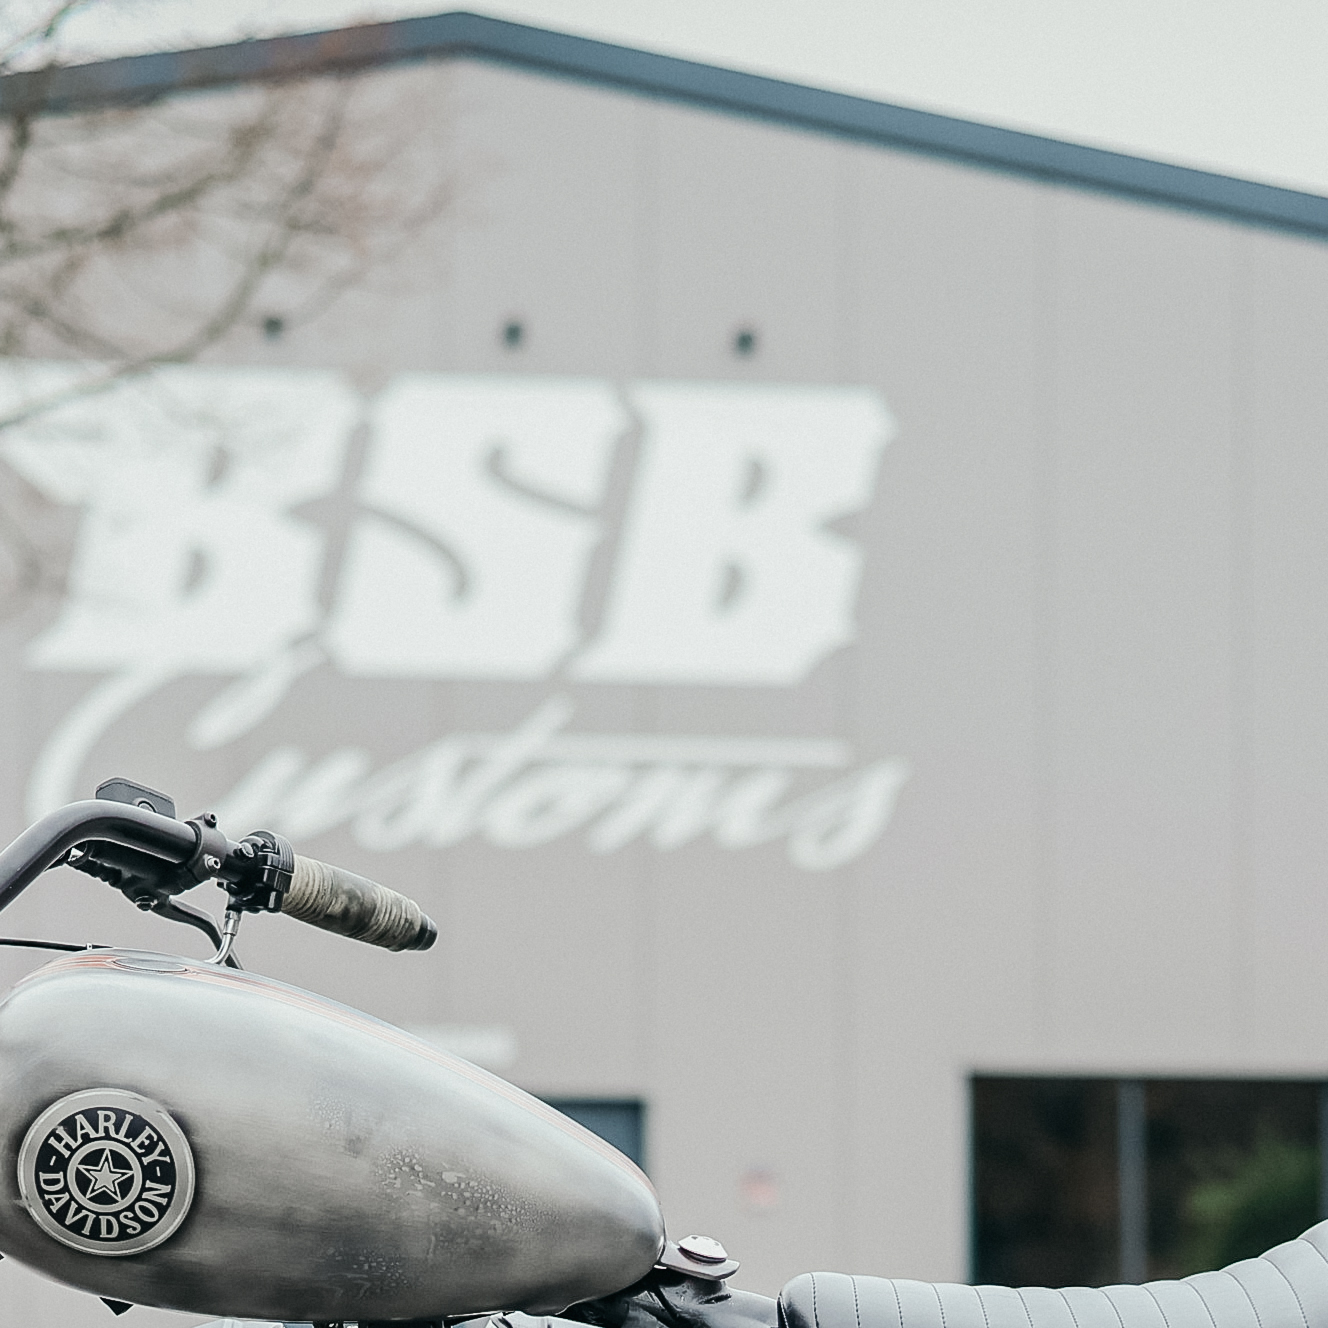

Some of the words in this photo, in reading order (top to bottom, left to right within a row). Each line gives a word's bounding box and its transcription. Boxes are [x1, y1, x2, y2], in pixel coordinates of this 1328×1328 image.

[26, 640, 912, 872] Customs
[47, 1109, 171, 1165] HARLEY
[38, 1171, 172, 1239] DAVIDSON
